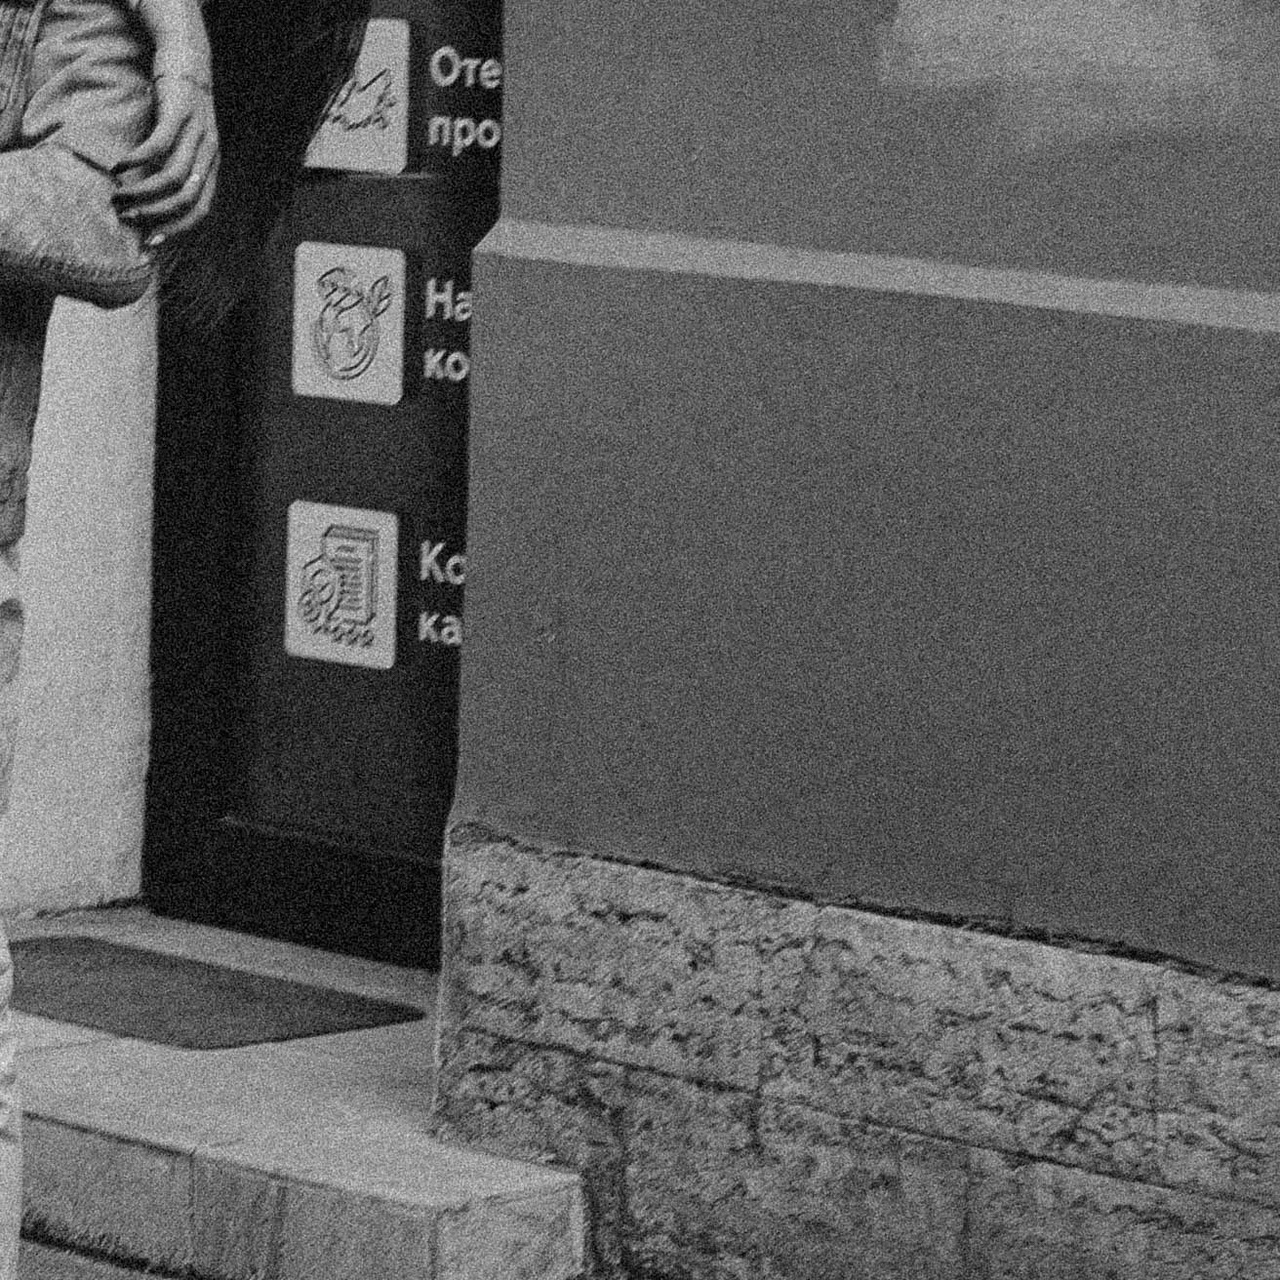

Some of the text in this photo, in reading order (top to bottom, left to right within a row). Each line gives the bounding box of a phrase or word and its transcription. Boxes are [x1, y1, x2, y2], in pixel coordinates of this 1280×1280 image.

[429, 45, 503, 90] Оте
[428, 116, 502, 157] про
[425, 277, 472, 322] На
[423, 348, 471, 382] ко
